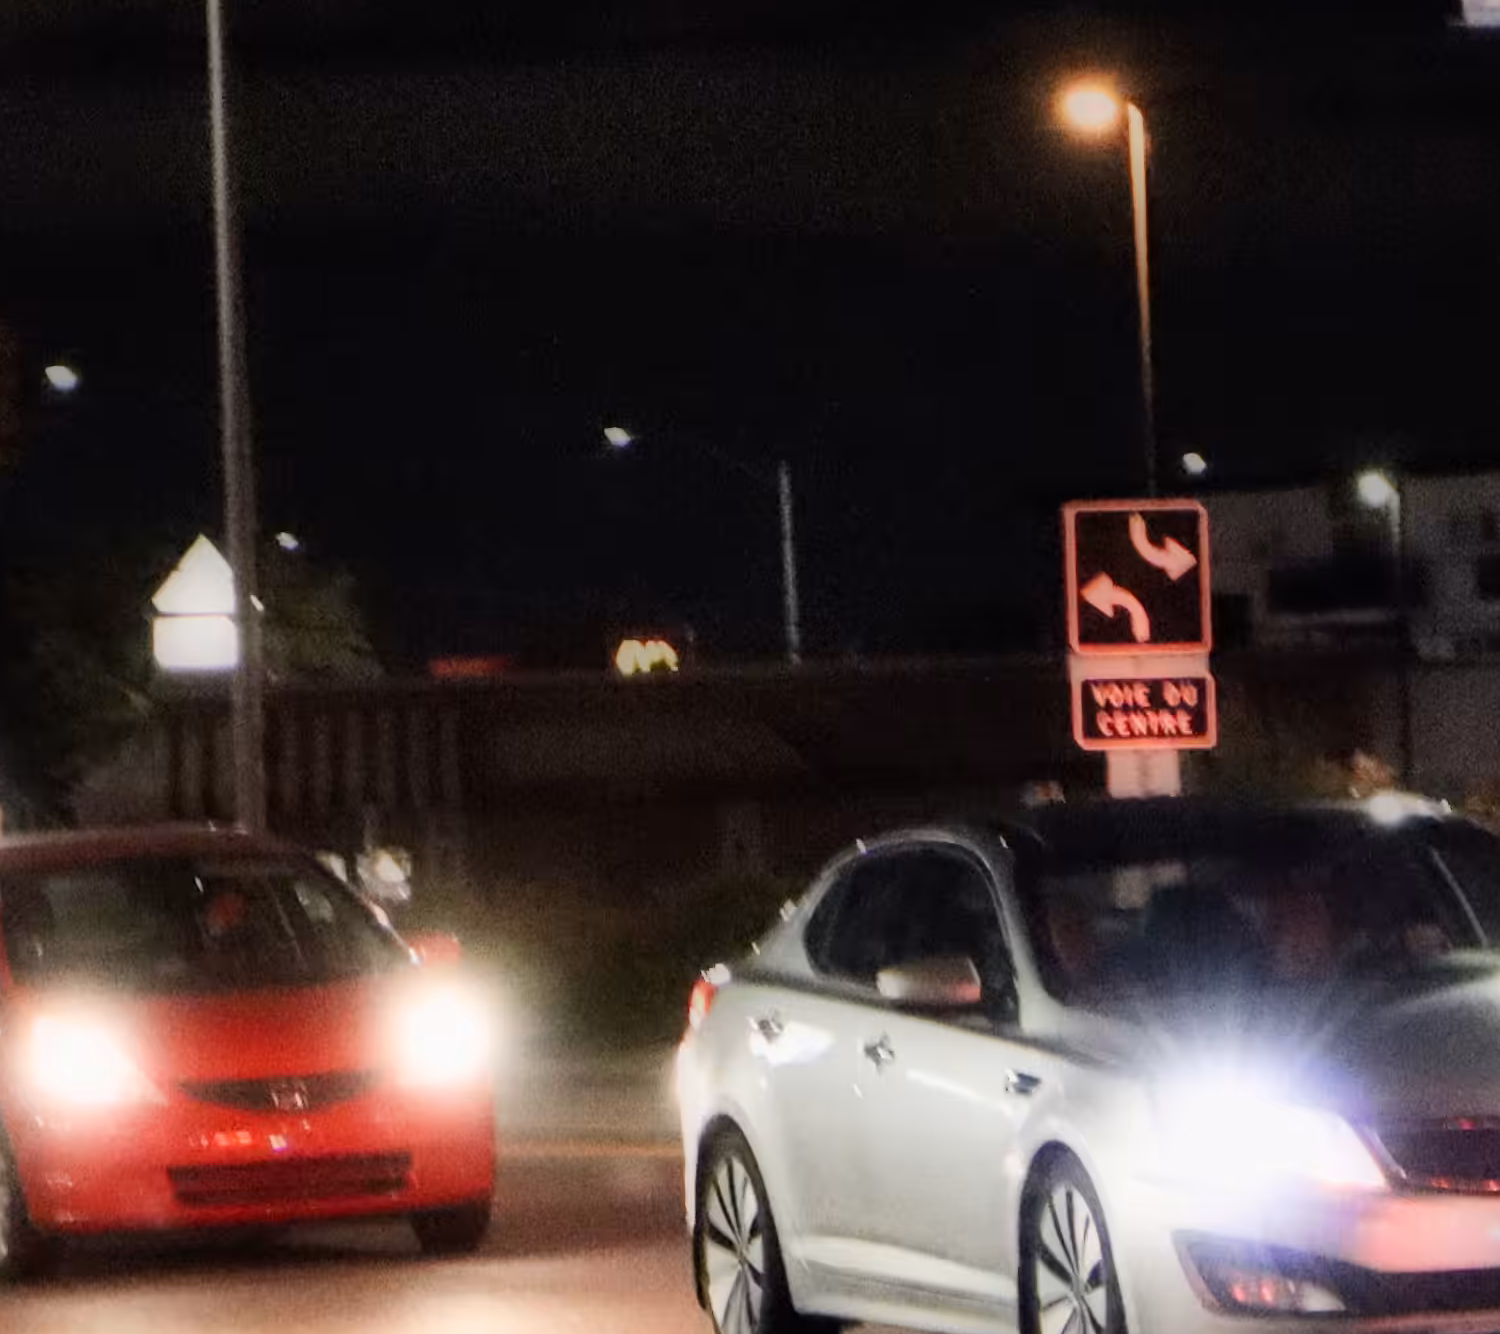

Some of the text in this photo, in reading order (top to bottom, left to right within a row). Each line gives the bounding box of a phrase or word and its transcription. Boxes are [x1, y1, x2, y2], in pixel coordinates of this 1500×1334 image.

[1091, 680, 1198, 708] VOIE DU
[1095, 709, 1193, 737] CENTRE
